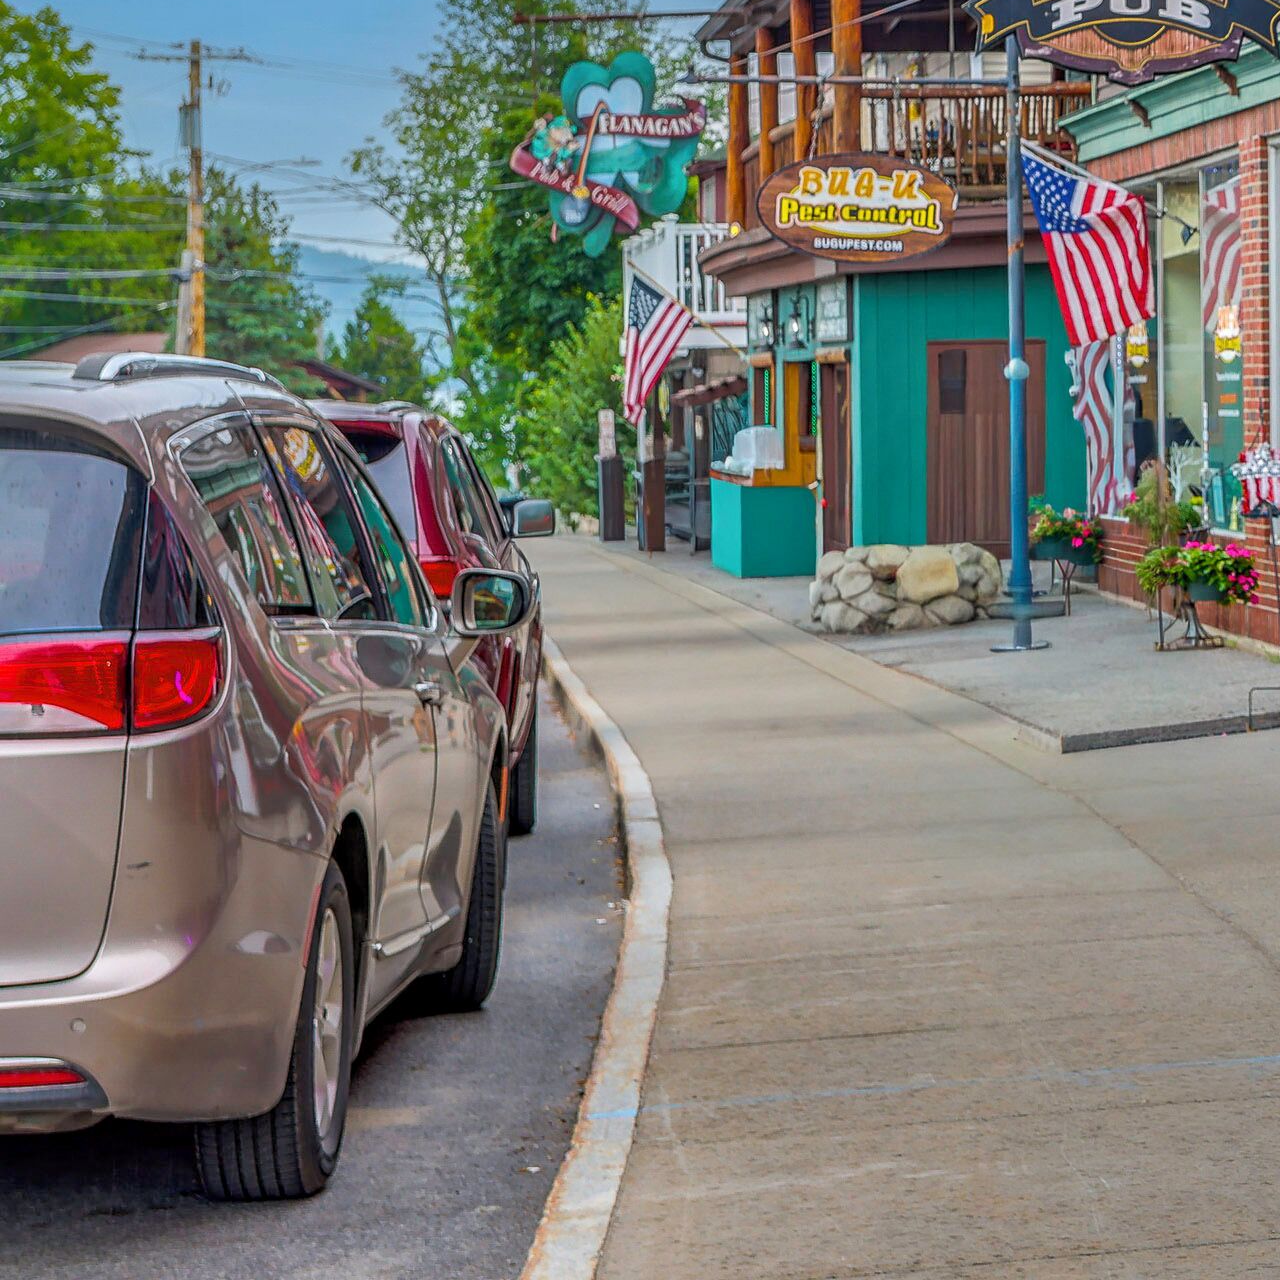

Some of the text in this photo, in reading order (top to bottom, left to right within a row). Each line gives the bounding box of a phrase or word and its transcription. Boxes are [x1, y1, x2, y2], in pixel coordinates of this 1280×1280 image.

[598, 111, 705, 136] FLANAGAN'S
[561, 174, 575, 193] &
[591, 186, 630, 214] Grill
[799, 168, 921, 201] BUG-U
[779, 196, 940, 231] Pest Control
[813, 237, 904, 253] BUGUPEST.COM
